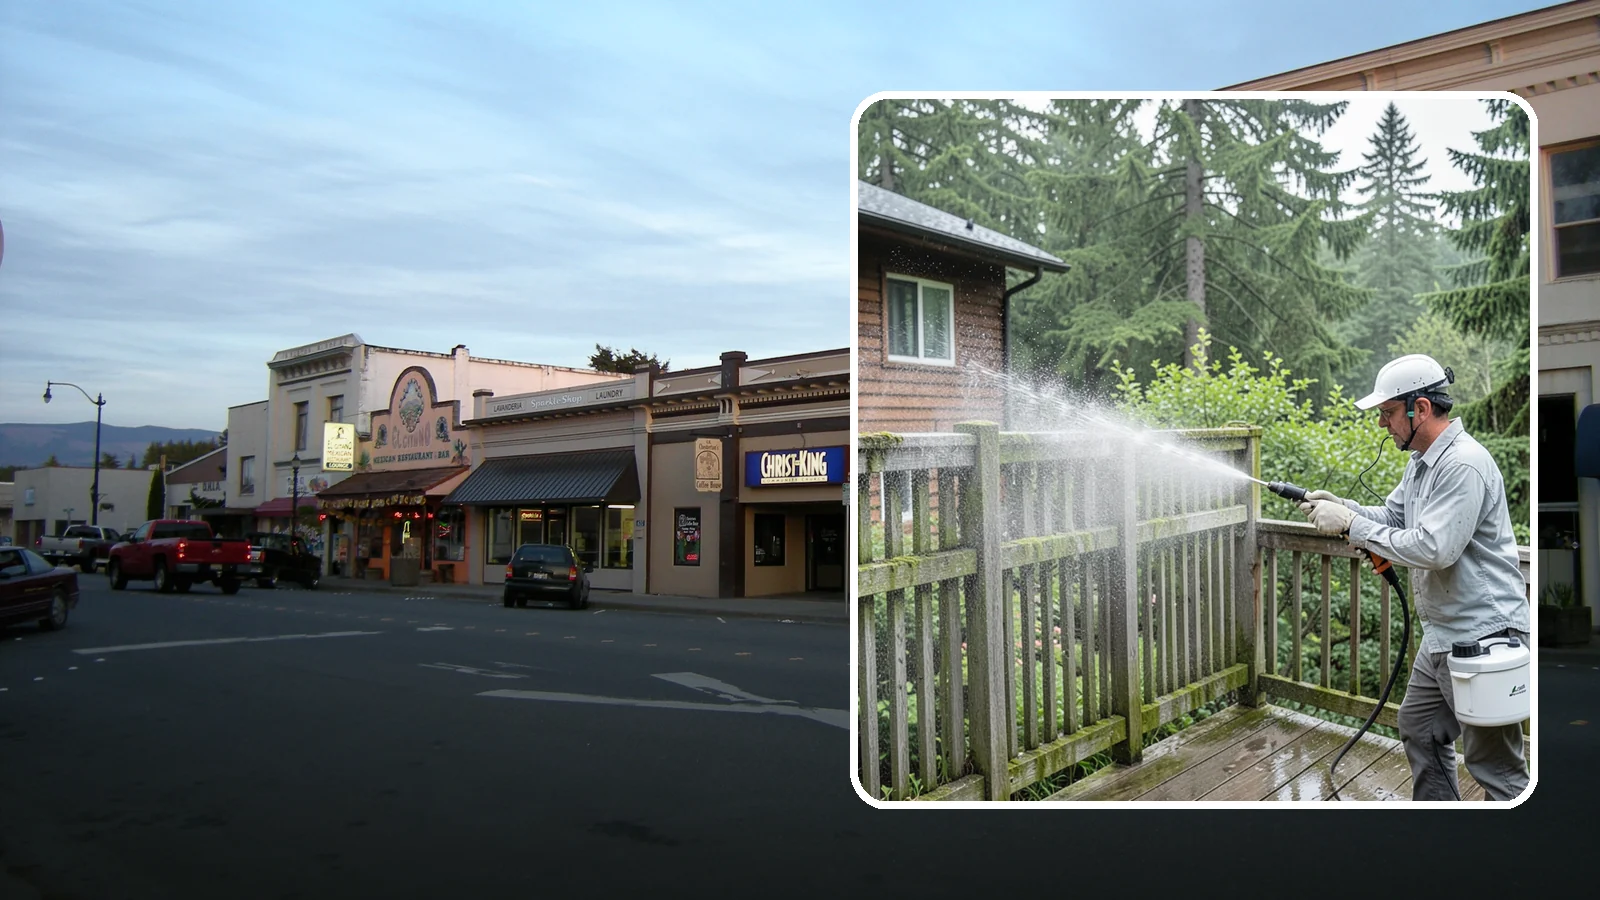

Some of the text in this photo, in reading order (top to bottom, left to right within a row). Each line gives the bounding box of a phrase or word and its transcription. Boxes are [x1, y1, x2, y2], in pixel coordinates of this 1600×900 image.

[493, 402, 523, 413] LAVANDERIA
[562, 394, 583, 406] Shop
[595, 389, 624, 400] LAUNDRY
[373, 455, 396, 464] MEXICAN
[397, 451, 433, 462] RESTAURANT
[437, 450, 450, 459] BAR
[761, 450, 827, 478] CHRIST KING
